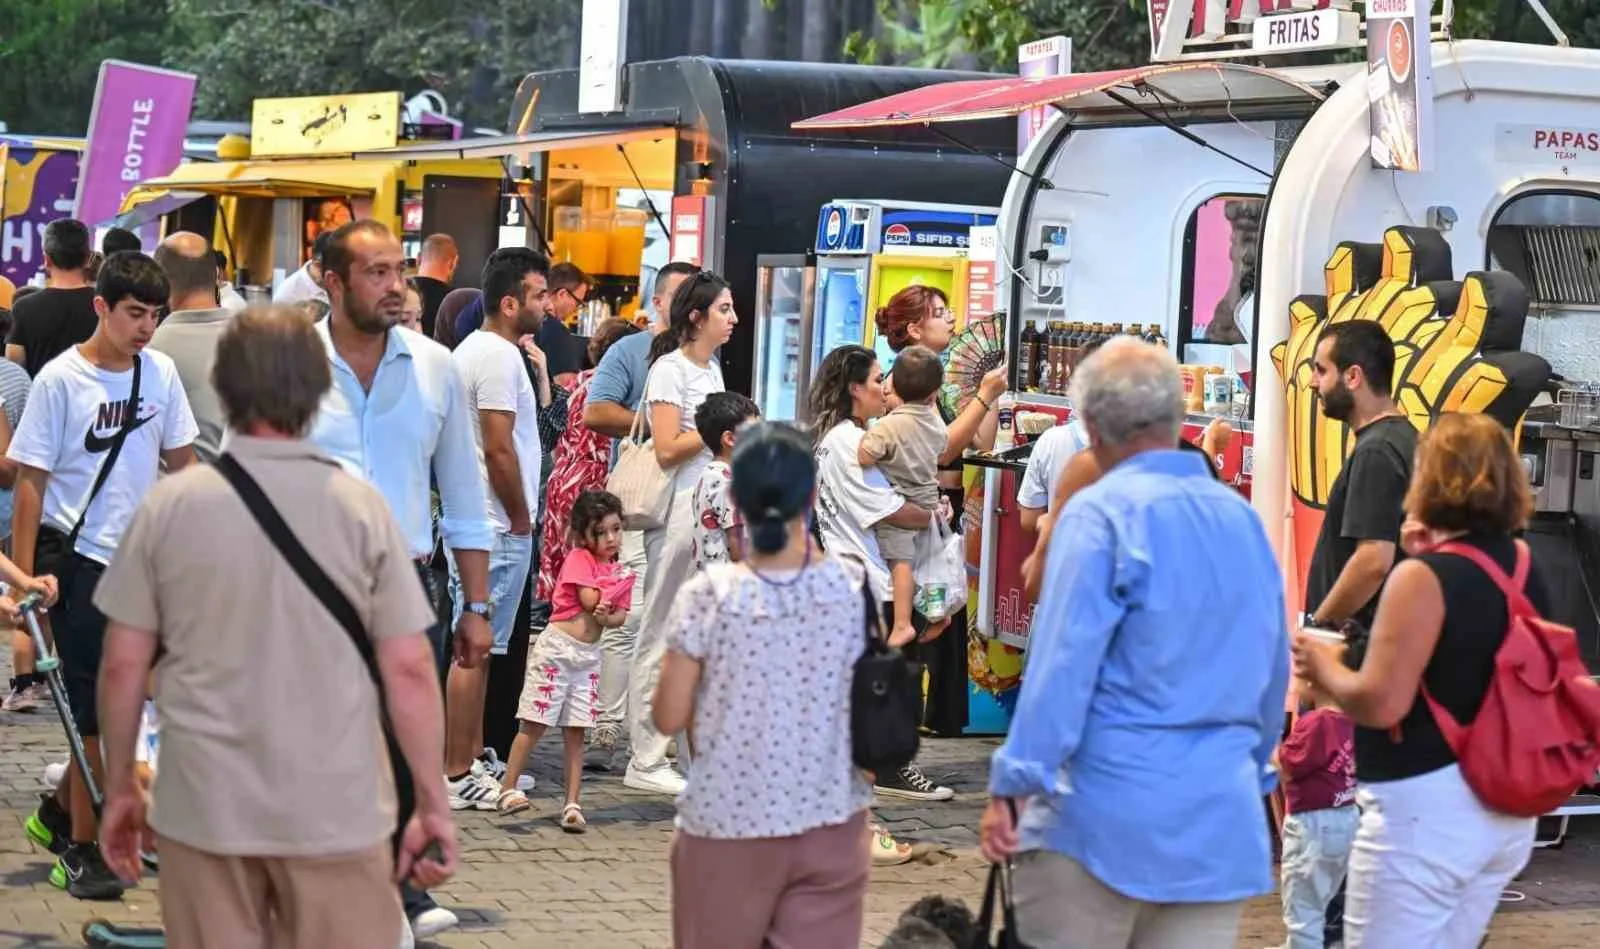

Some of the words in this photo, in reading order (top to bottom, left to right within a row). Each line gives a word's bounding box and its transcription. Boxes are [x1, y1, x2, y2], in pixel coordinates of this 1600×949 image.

[1268, 14, 1321, 45] FRITAS
[121, 98, 154, 181] BOTTLE
[1534, 130, 1600, 151] PAPAS
[1554, 151, 1577, 160] TEAM
[886, 233, 911, 241] PEPSI
[916, 233, 953, 245] SIFIR
